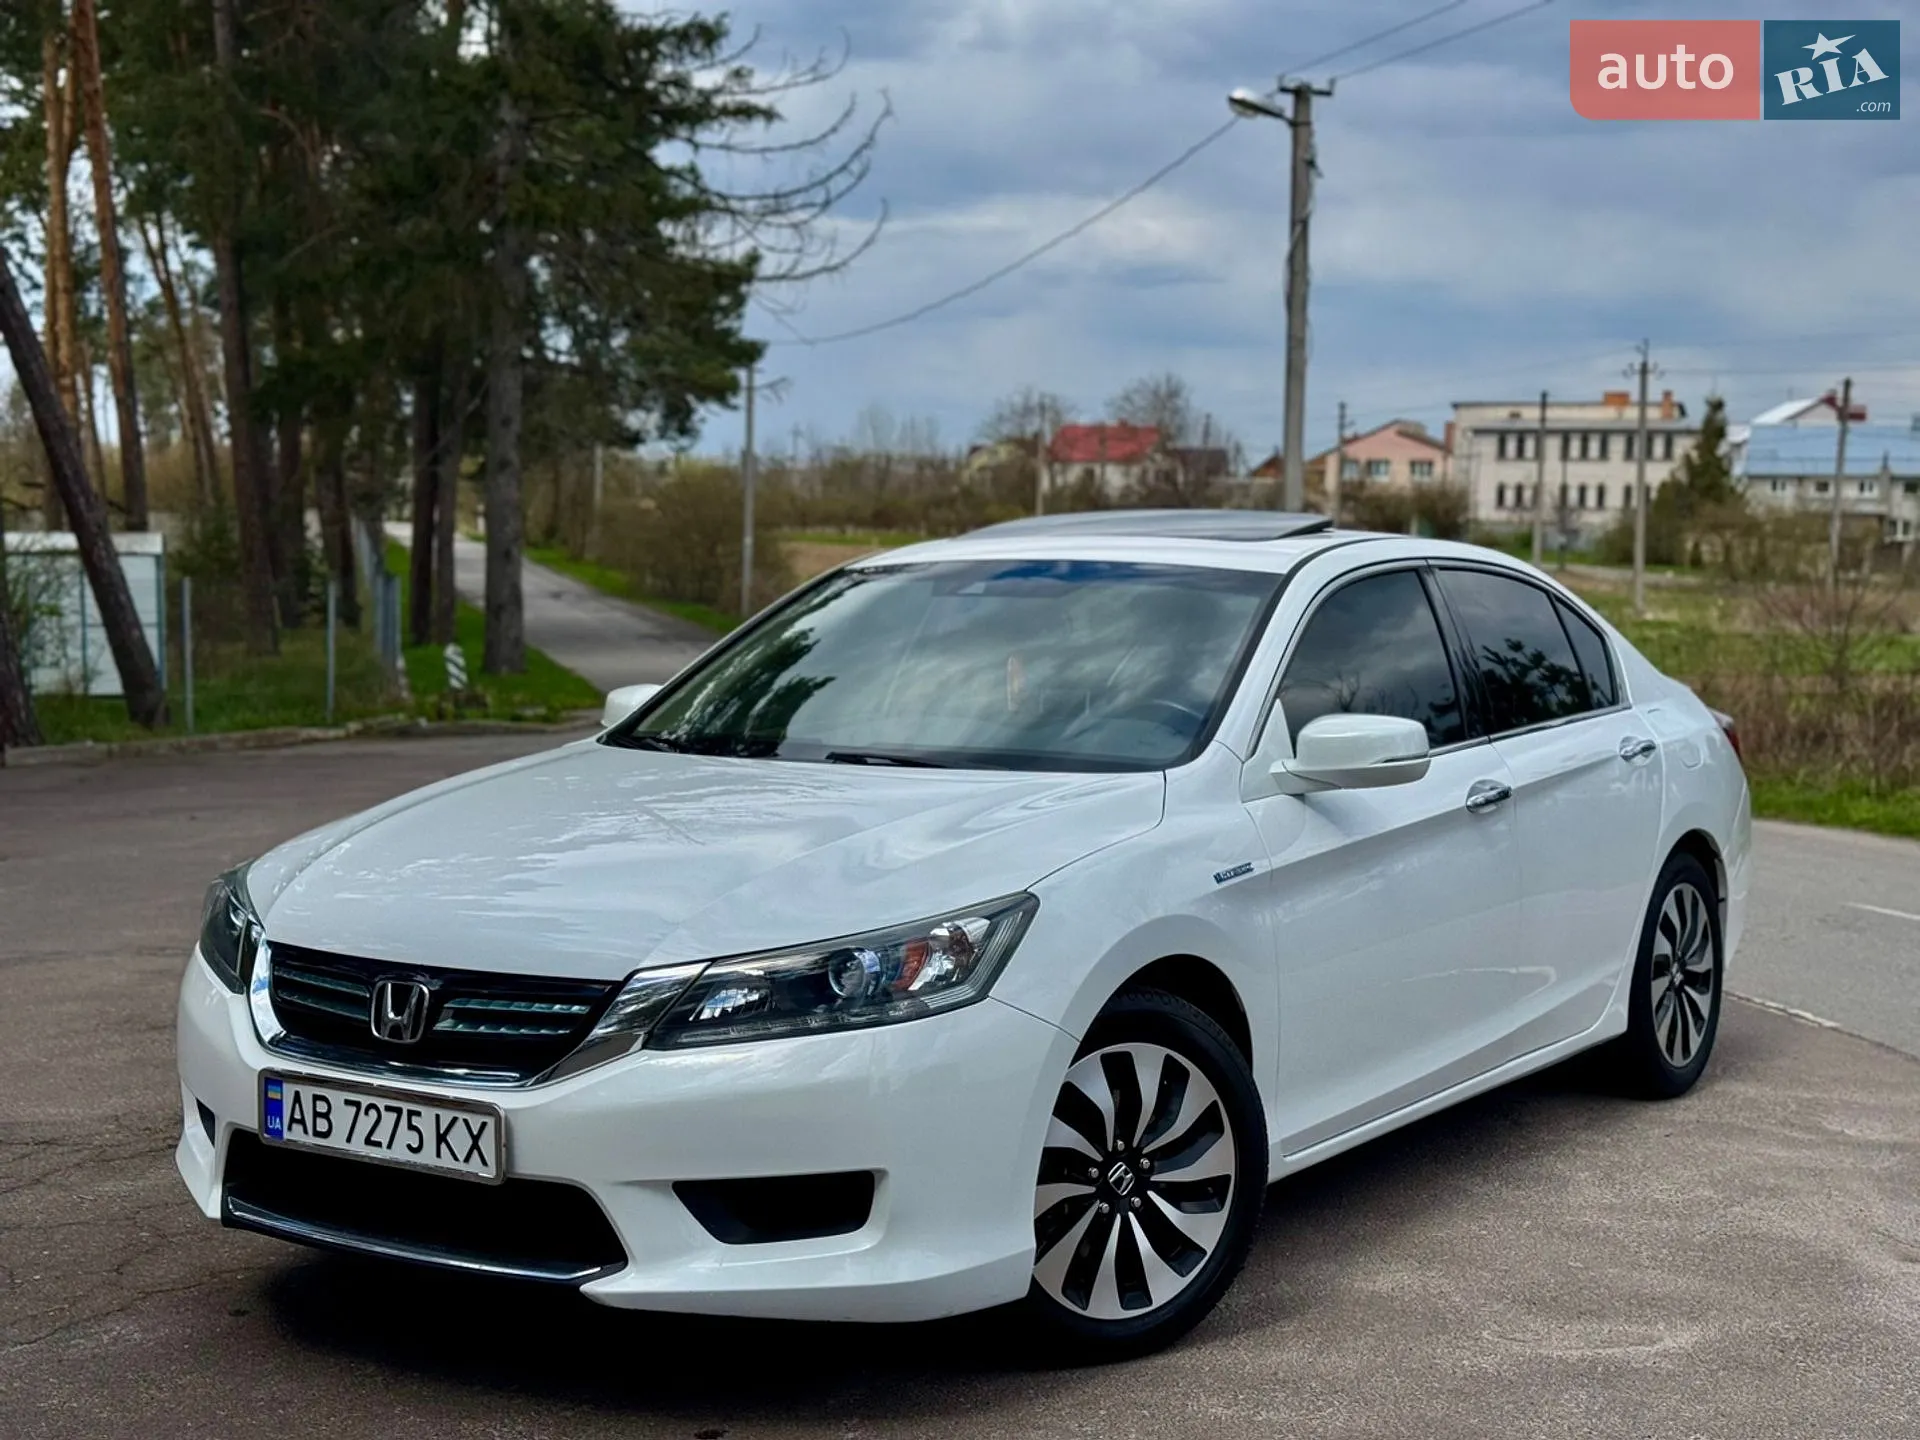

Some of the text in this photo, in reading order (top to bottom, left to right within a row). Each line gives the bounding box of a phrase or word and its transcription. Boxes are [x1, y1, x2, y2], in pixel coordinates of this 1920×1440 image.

[267, 1115, 282, 1130] UA
[286, 1089, 489, 1167] AB 7275 KX
